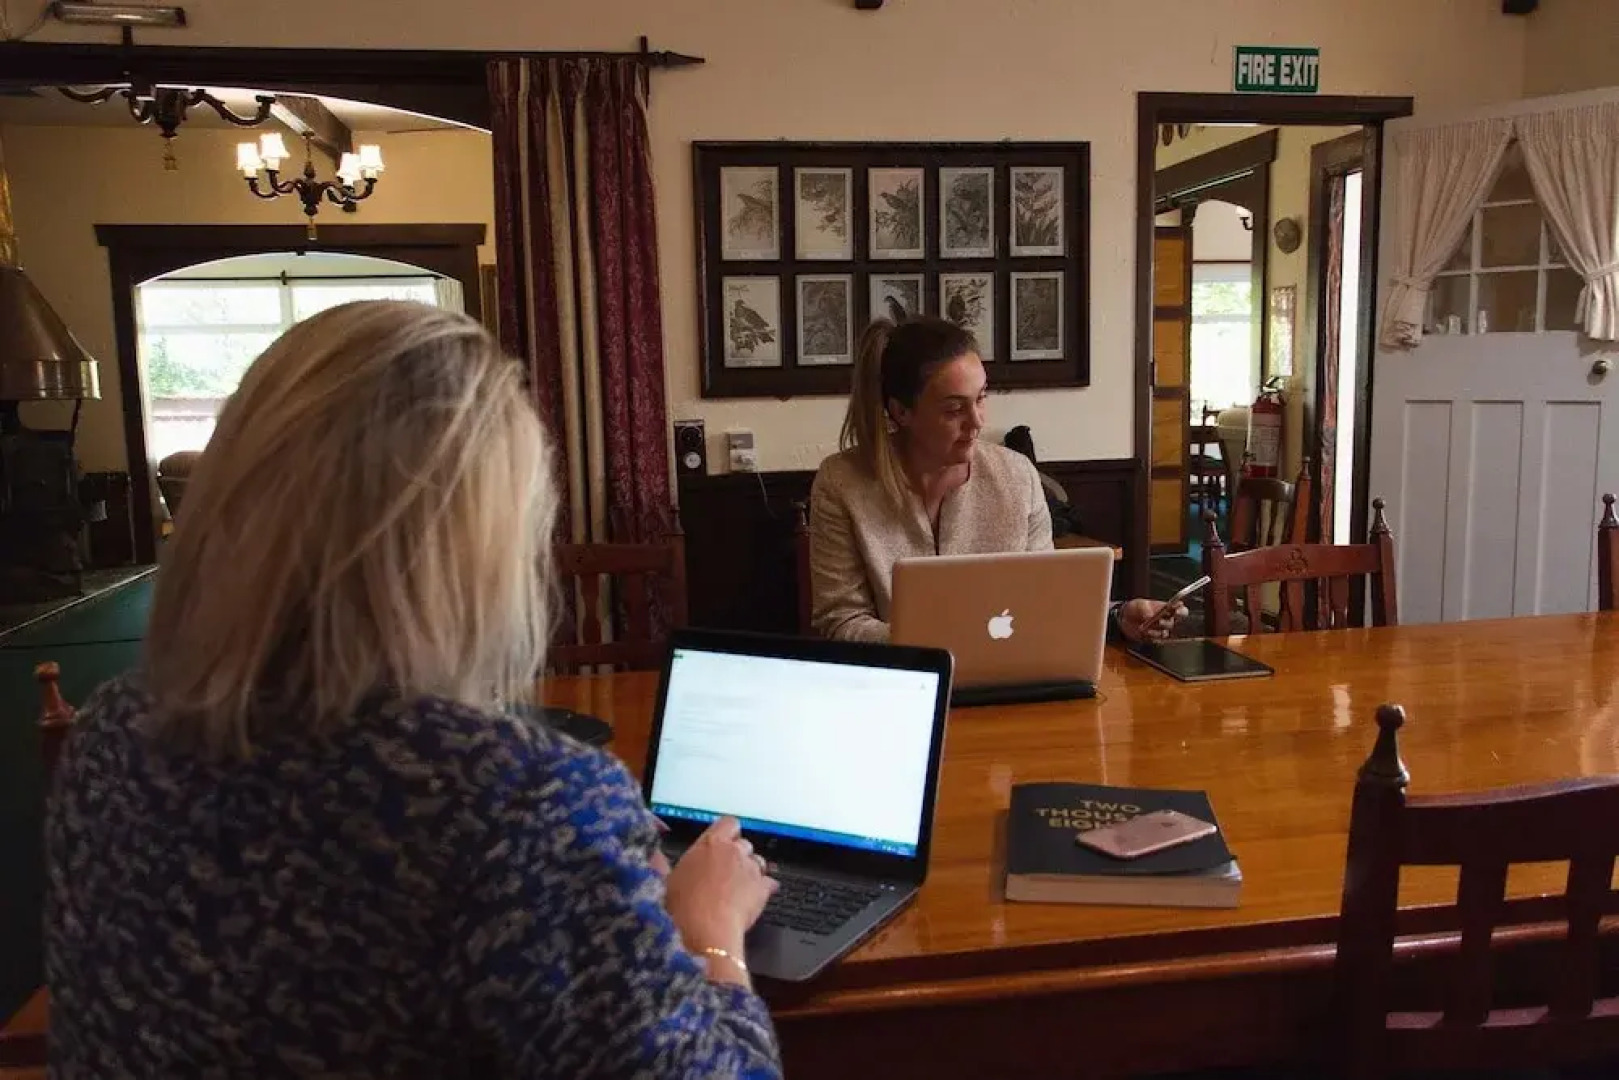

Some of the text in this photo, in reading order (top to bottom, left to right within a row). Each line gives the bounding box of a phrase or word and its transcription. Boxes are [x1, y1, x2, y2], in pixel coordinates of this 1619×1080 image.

[1238, 54, 1318, 86] FIRE EXIT
[1080, 799, 1141, 813] TWO
[1036, 807, 1128, 821] THOUS
